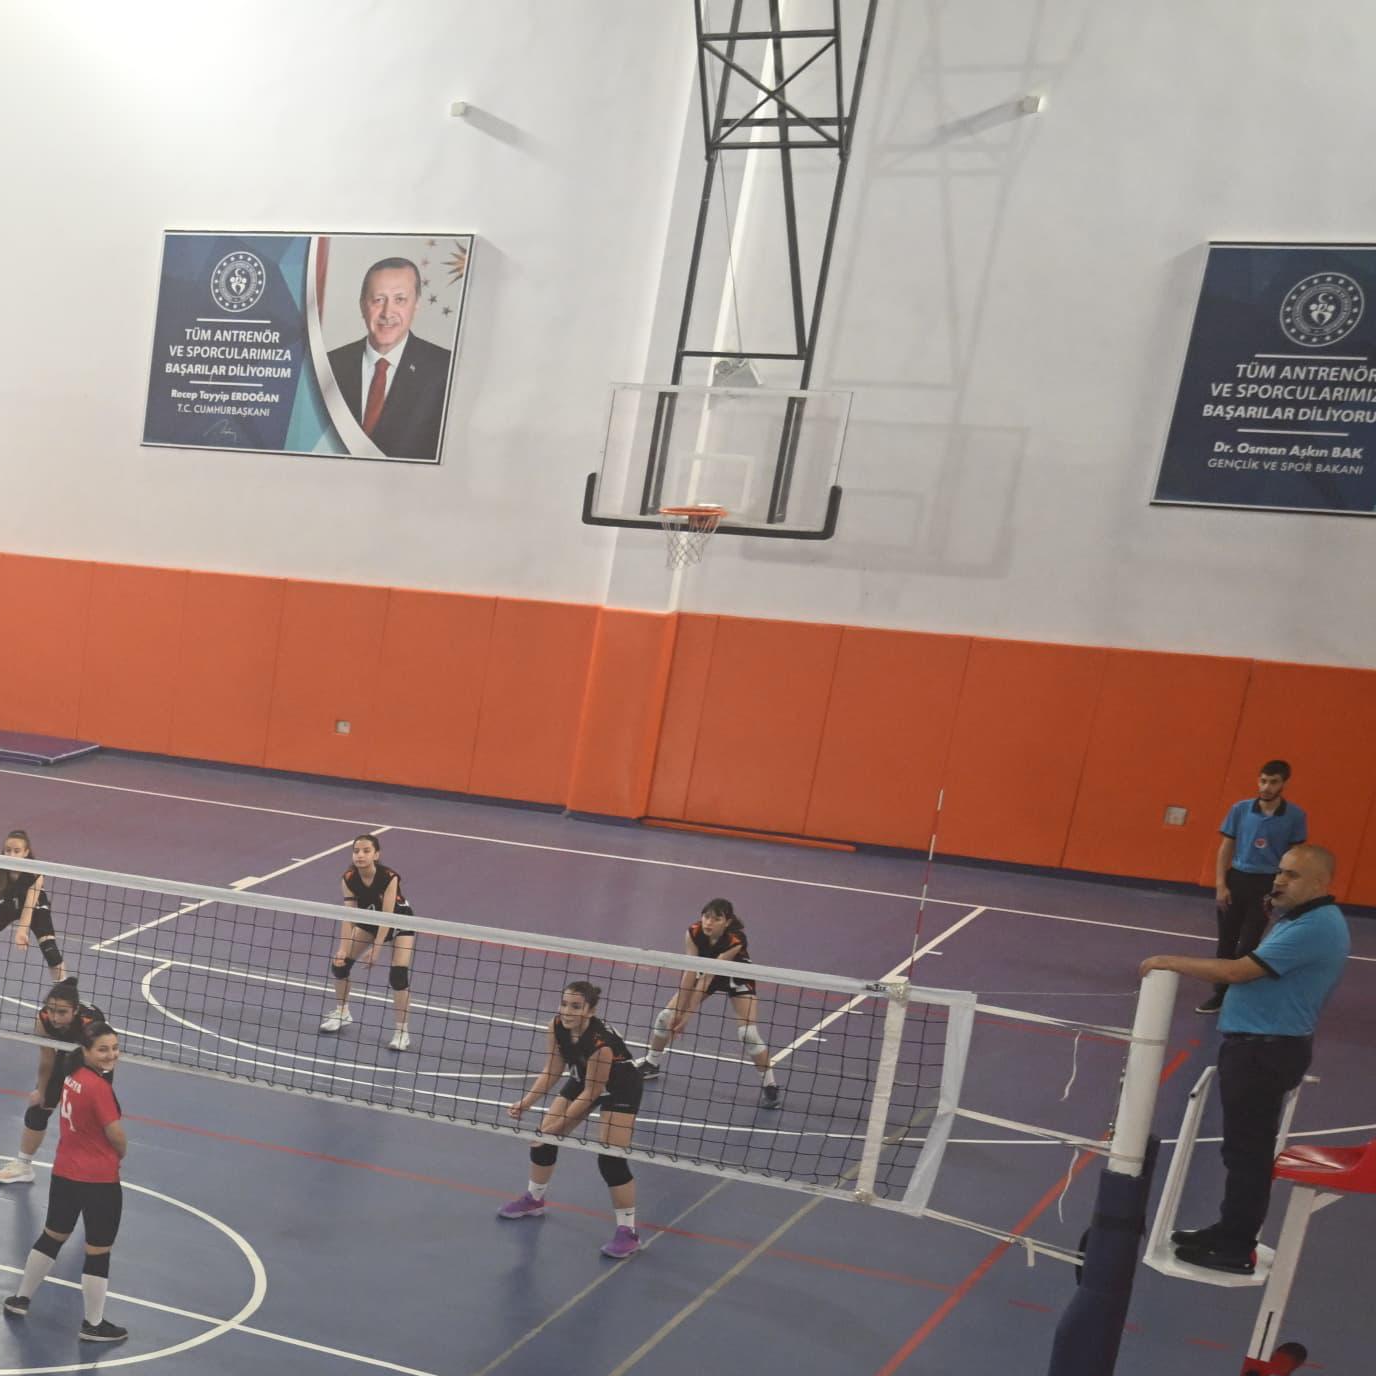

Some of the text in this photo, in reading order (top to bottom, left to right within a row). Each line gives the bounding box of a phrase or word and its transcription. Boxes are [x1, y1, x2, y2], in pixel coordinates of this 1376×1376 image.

[185, 327, 280, 343] TÜM ANTRENÖR
[169, 345, 292, 361] VE SPORCULARIMIZA
[165, 363, 292, 378] BAŞARILAR DİLİYORUM
[1236, 361, 1276, 379] TÜM
[171, 389, 279, 403] Recep Tayyip ERDOĞAN
[1210, 382, 1233, 397] VE
[193, 404, 270, 417] CUMHURBAŞKANI
[1202, 404, 1295, 421] BAŞARILAR
[1213, 441, 1364, 459] Dr. Osman Aşkın BAK
[1207, 458, 1364, 475] GENÇLİK VE SPOR BAKANI
